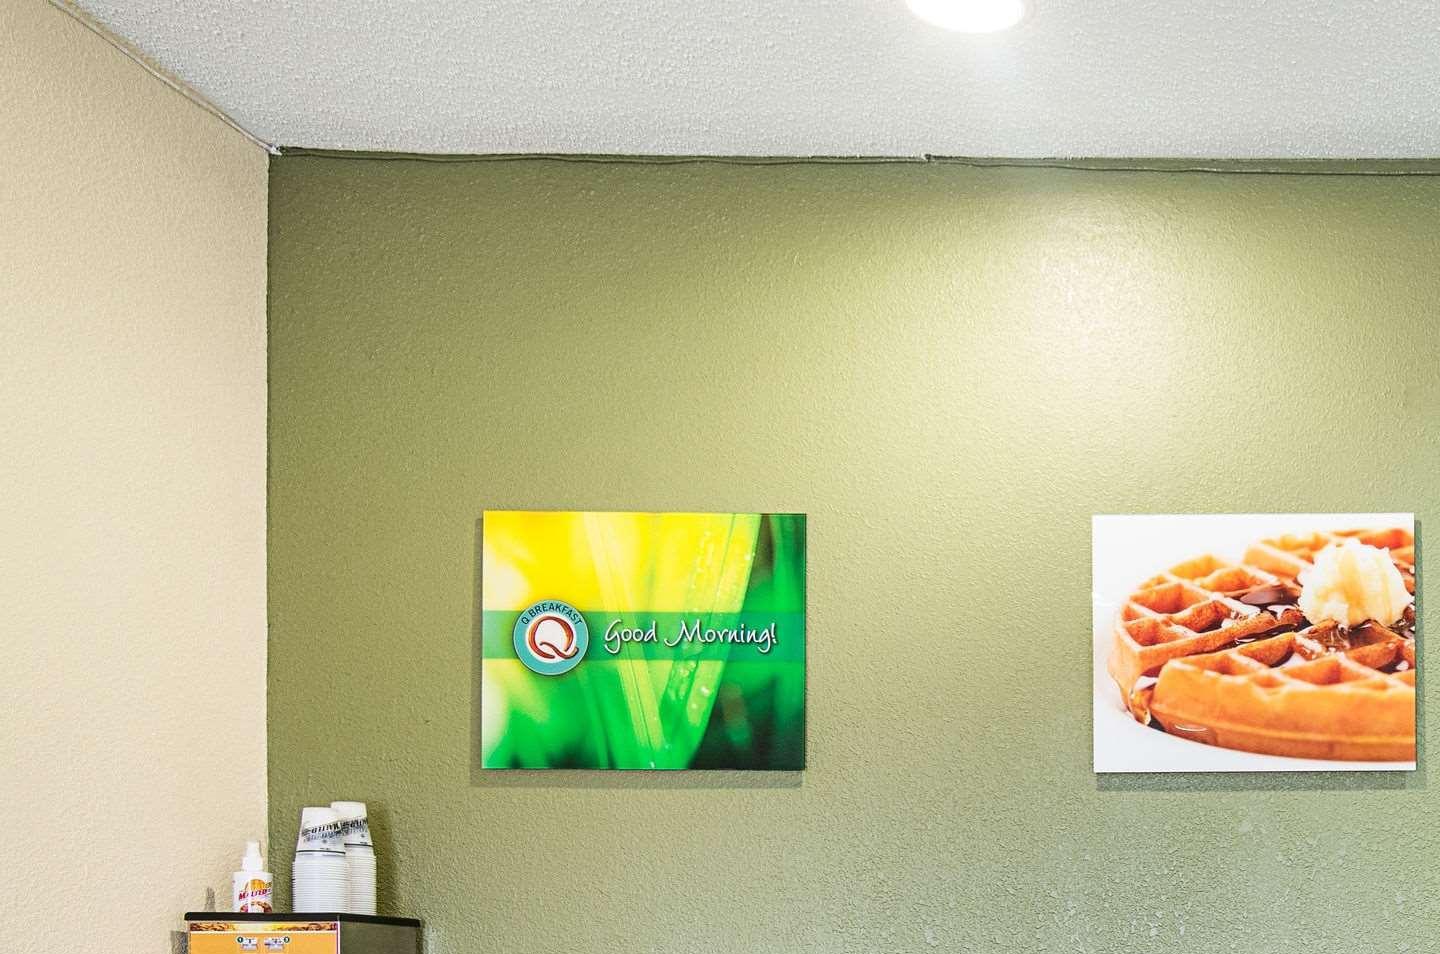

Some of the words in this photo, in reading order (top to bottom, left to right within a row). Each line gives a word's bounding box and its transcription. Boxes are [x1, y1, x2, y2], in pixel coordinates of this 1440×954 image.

[520, 616, 530, 625] Q
[528, 602, 583, 625] BREAKFAST
[527, 615, 580, 659] Q
[604, 618, 658, 654] Good
[664, 618, 777, 654] Morning!
